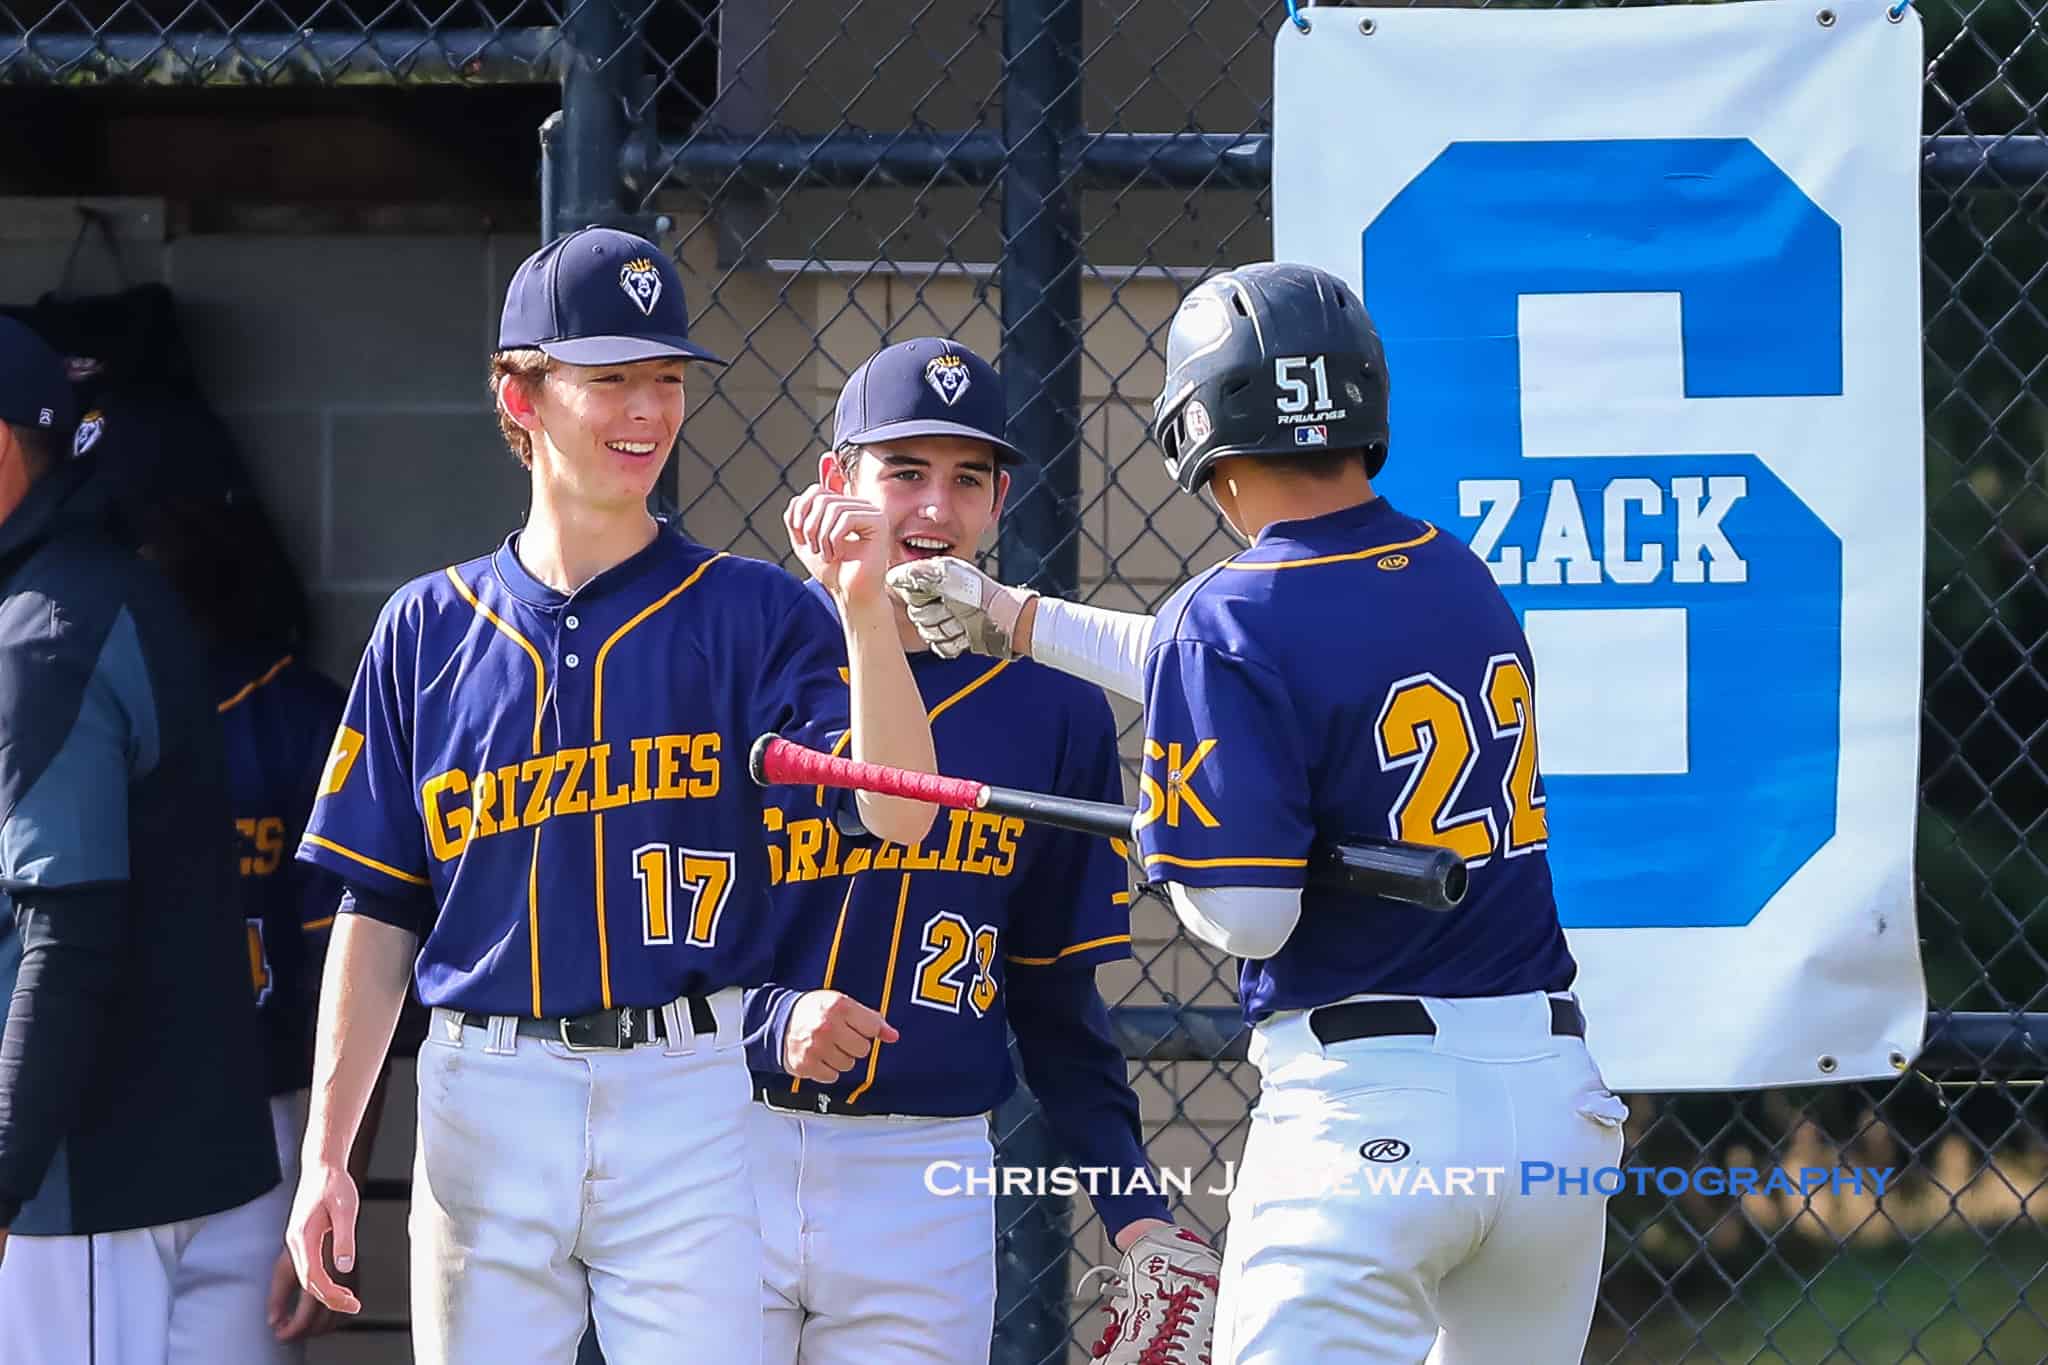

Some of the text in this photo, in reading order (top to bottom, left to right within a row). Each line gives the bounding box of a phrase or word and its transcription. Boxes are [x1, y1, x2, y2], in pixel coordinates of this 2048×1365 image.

[1275, 355, 1333, 412] 51
[1278, 409, 1346, 424] RAWLINGS
[1362, 137, 1843, 928] 6
[1457, 475, 1748, 585] ZACK
[422, 732, 721, 862] GRIZZLIES
[1374, 652, 1548, 870] 22
[632, 843, 736, 948] 17
